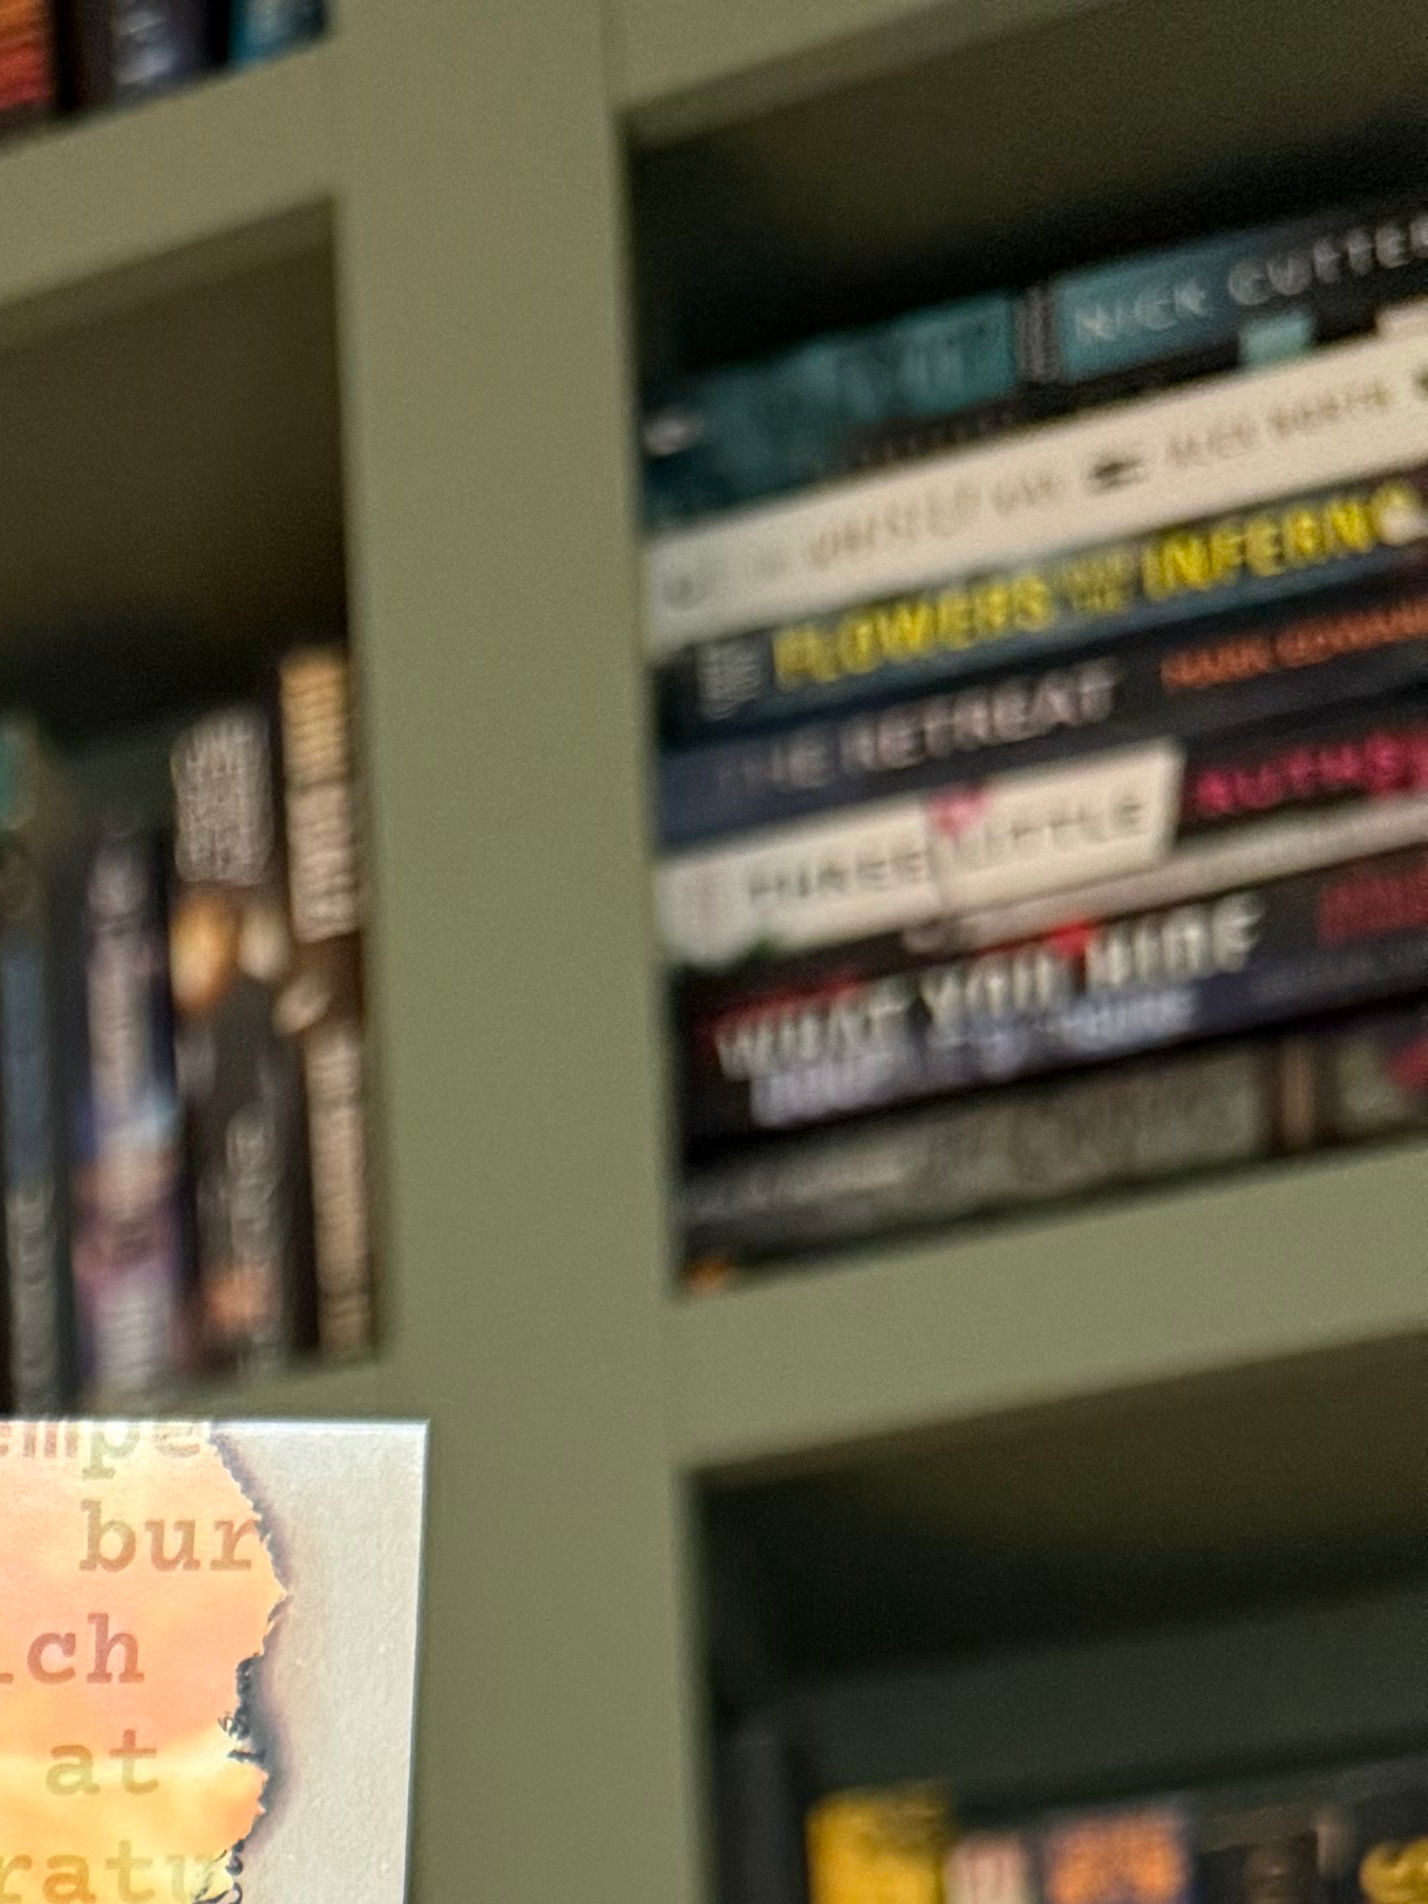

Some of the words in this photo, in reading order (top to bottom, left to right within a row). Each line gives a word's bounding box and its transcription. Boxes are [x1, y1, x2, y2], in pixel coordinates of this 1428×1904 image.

[772, 572, 1056, 692] FLOWERS
[841, 657, 1122, 770] RETREAT
[45, 1728, 160, 1798] at
